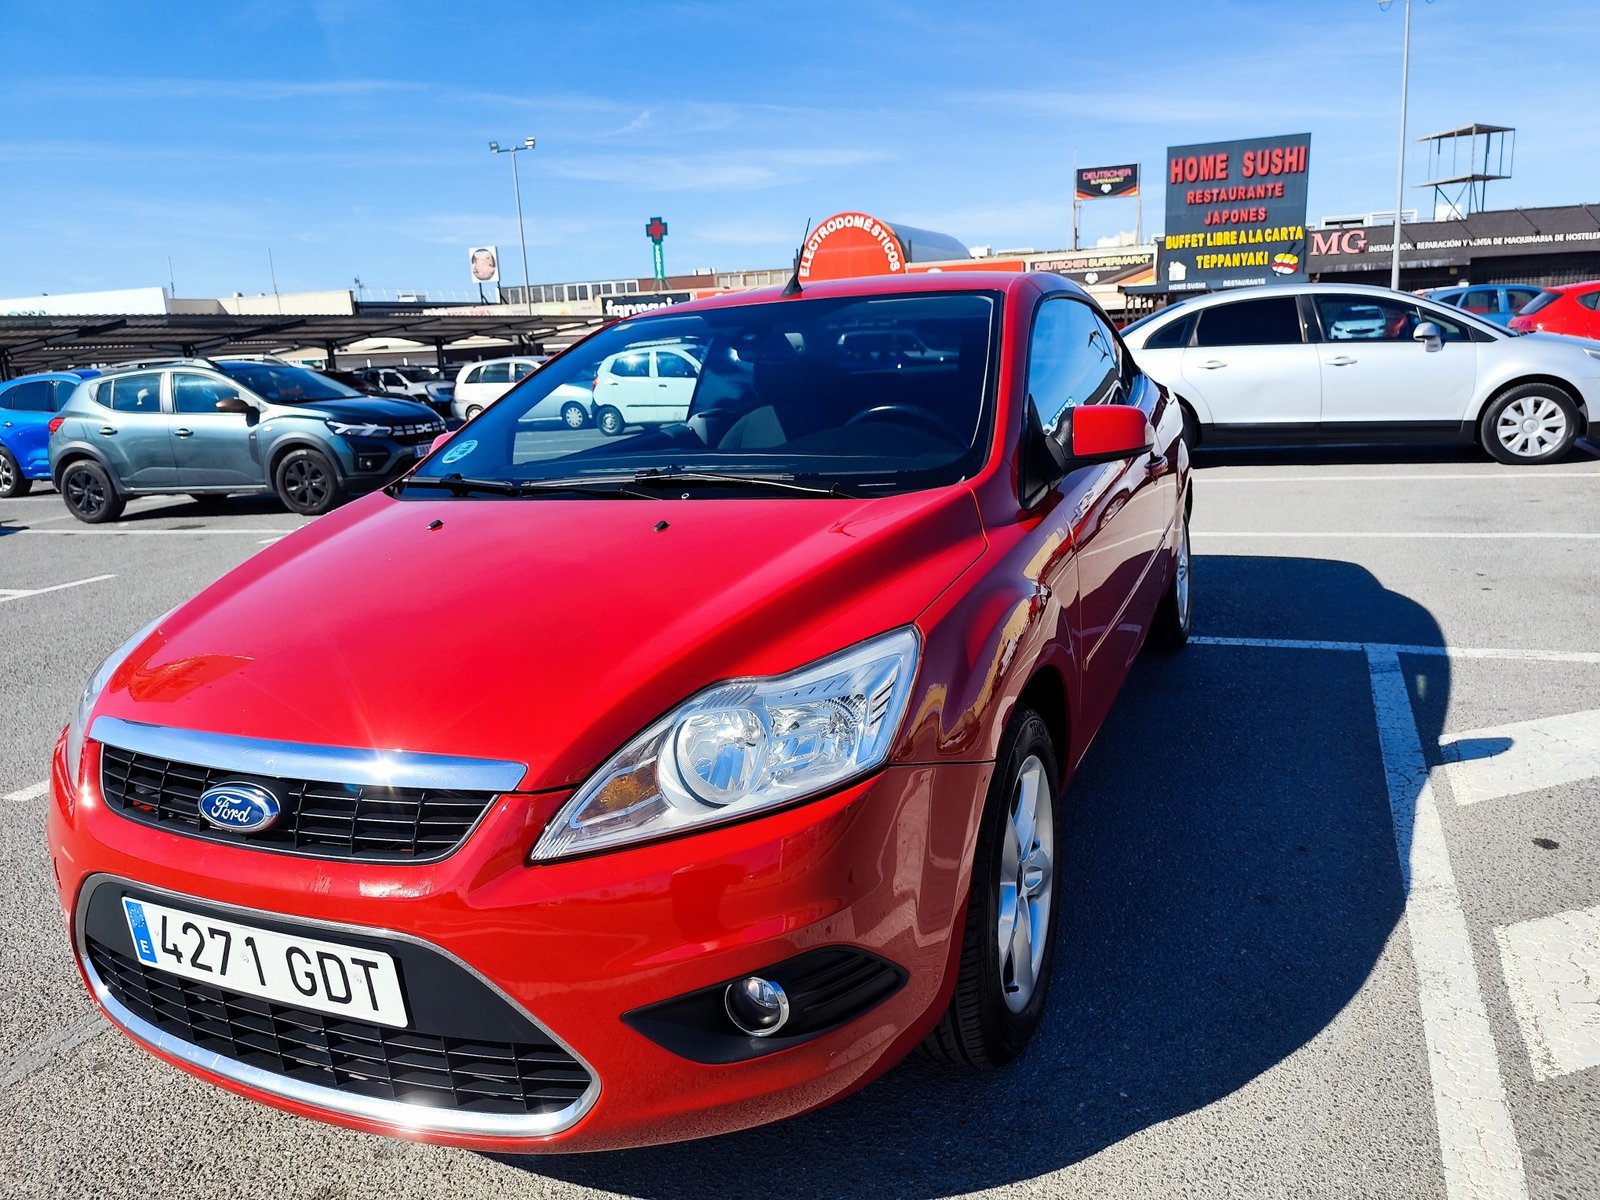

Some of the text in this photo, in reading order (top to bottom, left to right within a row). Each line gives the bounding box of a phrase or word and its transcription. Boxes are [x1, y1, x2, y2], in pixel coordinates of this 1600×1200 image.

[1082, 168, 1132, 180] DEUTSCHER
[1170, 145, 1306, 184] HOME SUSHI
[1187, 183, 1284, 204] RESTAURANTE
[1204, 207, 1267, 225] JAPONES
[800, 215, 900, 278] ELECTRODOMÉSTICOS
[1165, 226, 1304, 249] BUFFET LIBRE A LA CARTA
[1310, 230, 1368, 256] MG
[1416, 239, 1461, 250] REPARACIÓN
[1462, 239, 1468, 247] Y
[1493, 237, 1502, 245] DE
[1504, 234, 1553, 244] MAQUINARIA
[1554, 233, 1564, 241] DE
[1034, 259, 1087, 271] DEUTSCHER
[1088, 254, 1151, 267] SUPERMARKT
[1196, 251, 1269, 269] TEPPANYAKI
[210, 795, 252, 824] Ford
[140, 939, 151, 954] E
[160, 916, 380, 1012] 4271 GDT
